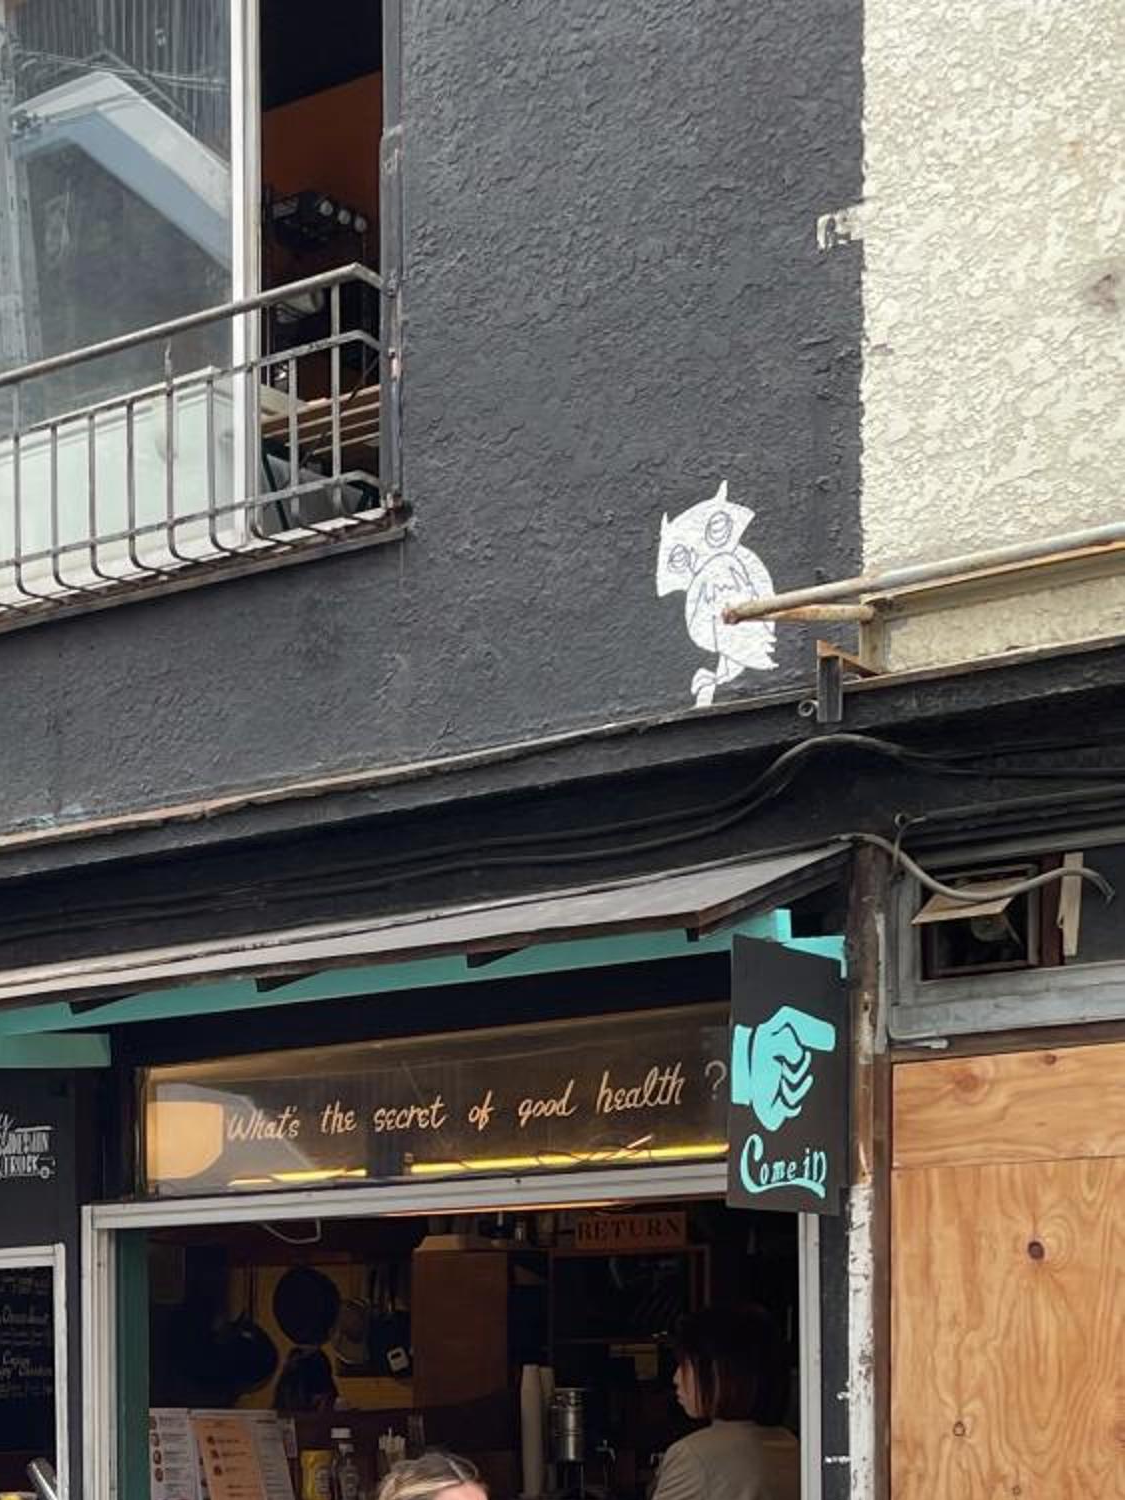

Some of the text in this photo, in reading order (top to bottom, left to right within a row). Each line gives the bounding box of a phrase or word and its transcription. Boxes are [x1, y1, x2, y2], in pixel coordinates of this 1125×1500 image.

[227, 1105, 300, 1141] What's
[321, 1100, 357, 1135] the
[373, 1095, 447, 1132] secret
[468, 1090, 495, 1131] of
[518, 1079, 577, 1128] good
[596, 1061, 686, 1115] health
[740, 1133, 827, 1193] Come in
[578, 1218, 681, 1242] RETURN
